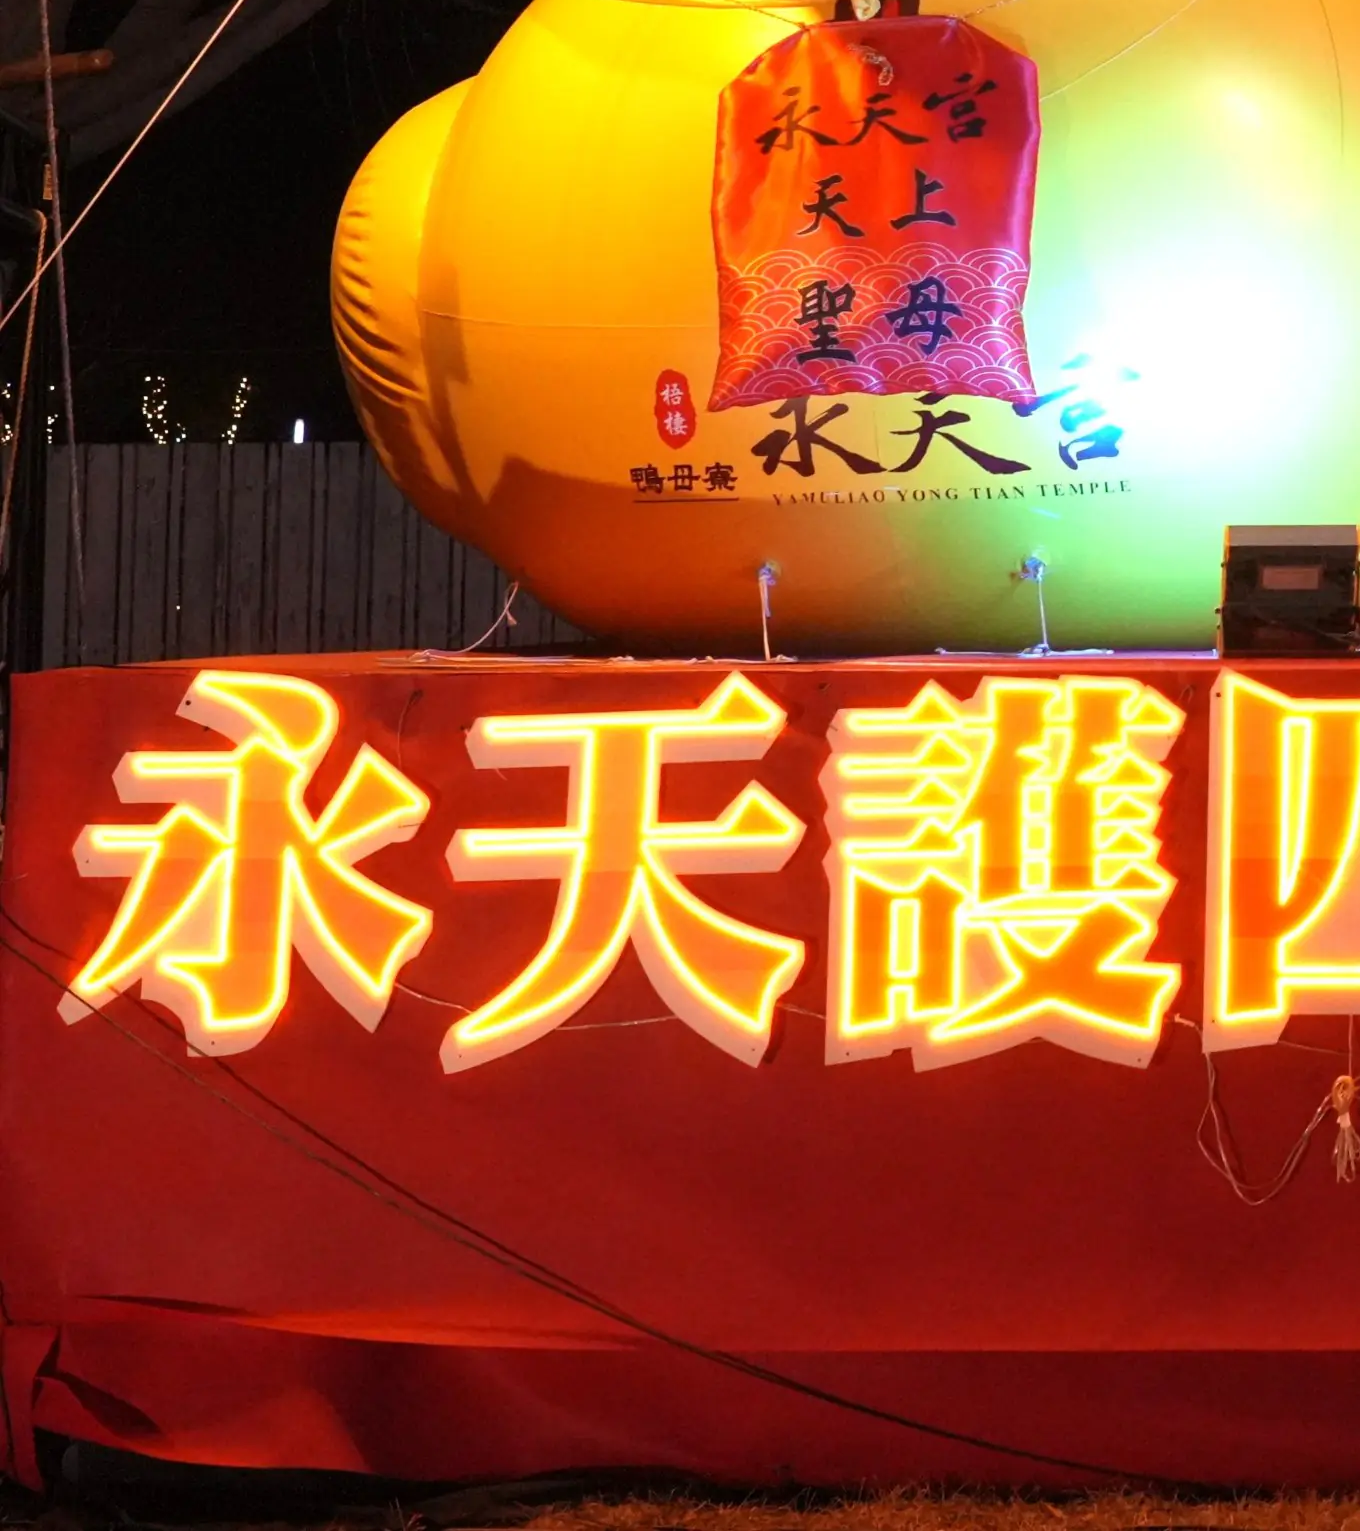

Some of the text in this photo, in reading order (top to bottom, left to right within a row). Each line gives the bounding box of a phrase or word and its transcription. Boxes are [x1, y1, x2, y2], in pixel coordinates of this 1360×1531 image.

[755, 72, 997, 154] 永天宮
[659, 382, 689, 436] 梧棲
[772, 480, 1132, 506] YAMULIAO YONG TIAN TEMPLE
